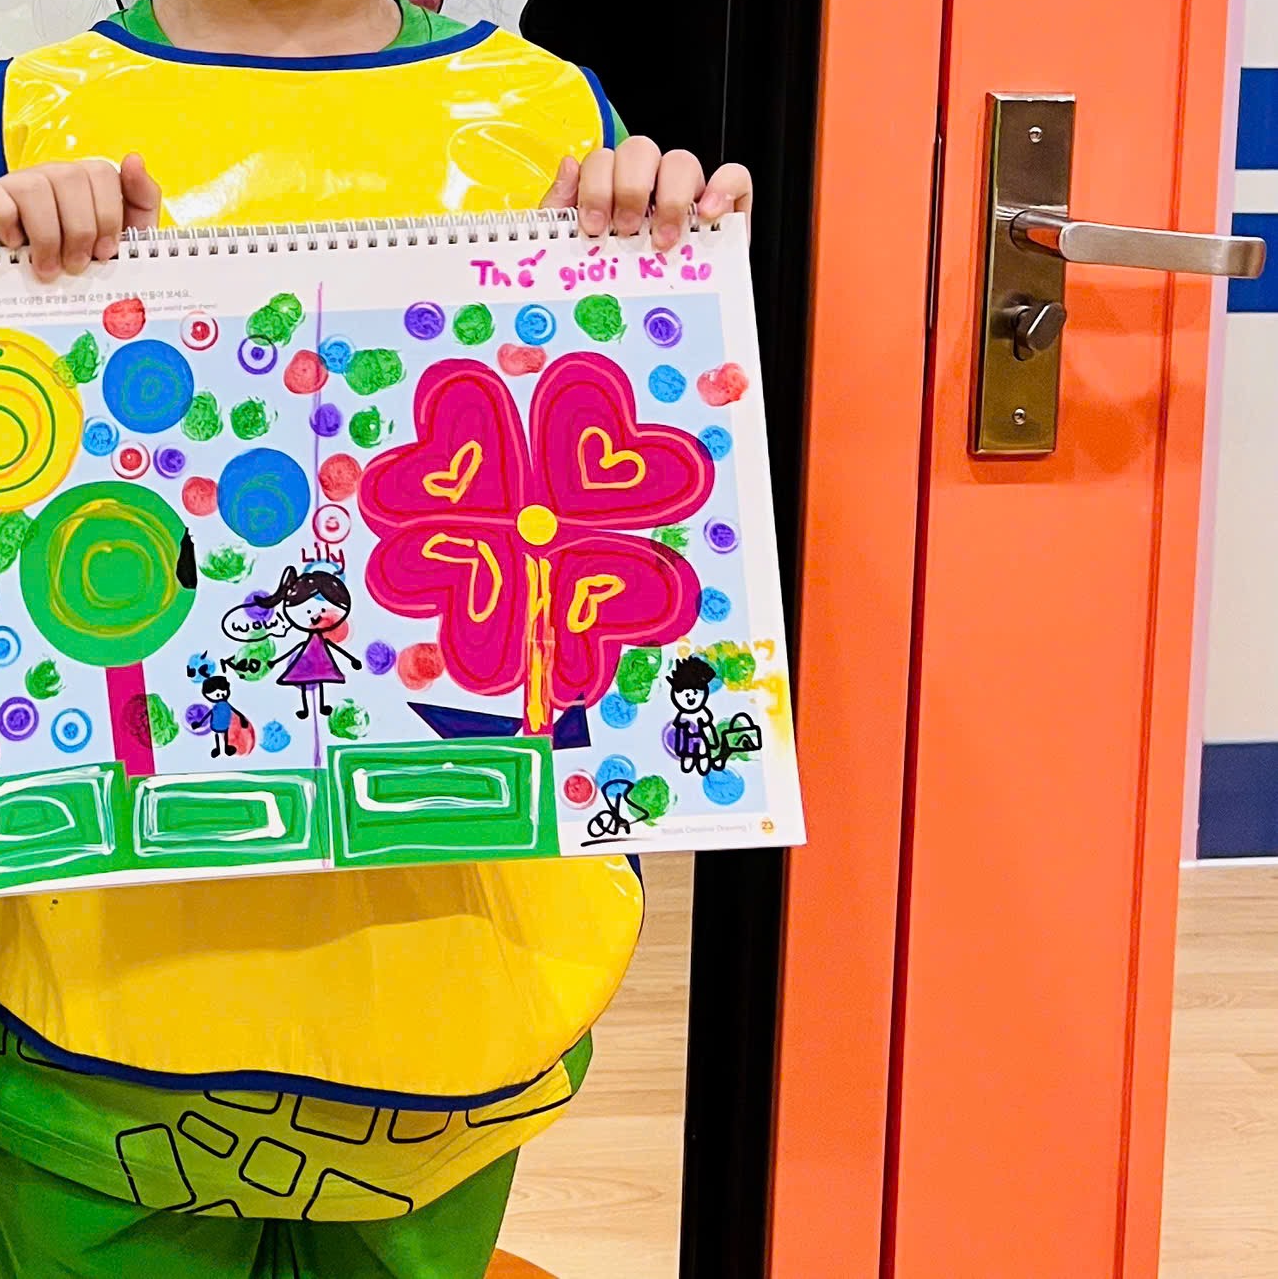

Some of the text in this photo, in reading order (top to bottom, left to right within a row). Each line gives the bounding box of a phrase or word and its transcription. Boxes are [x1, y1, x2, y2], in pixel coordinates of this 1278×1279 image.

[470, 249, 547, 287] Thế
[559, 246, 619, 291] giới
[761, 821, 775, 831] 23
